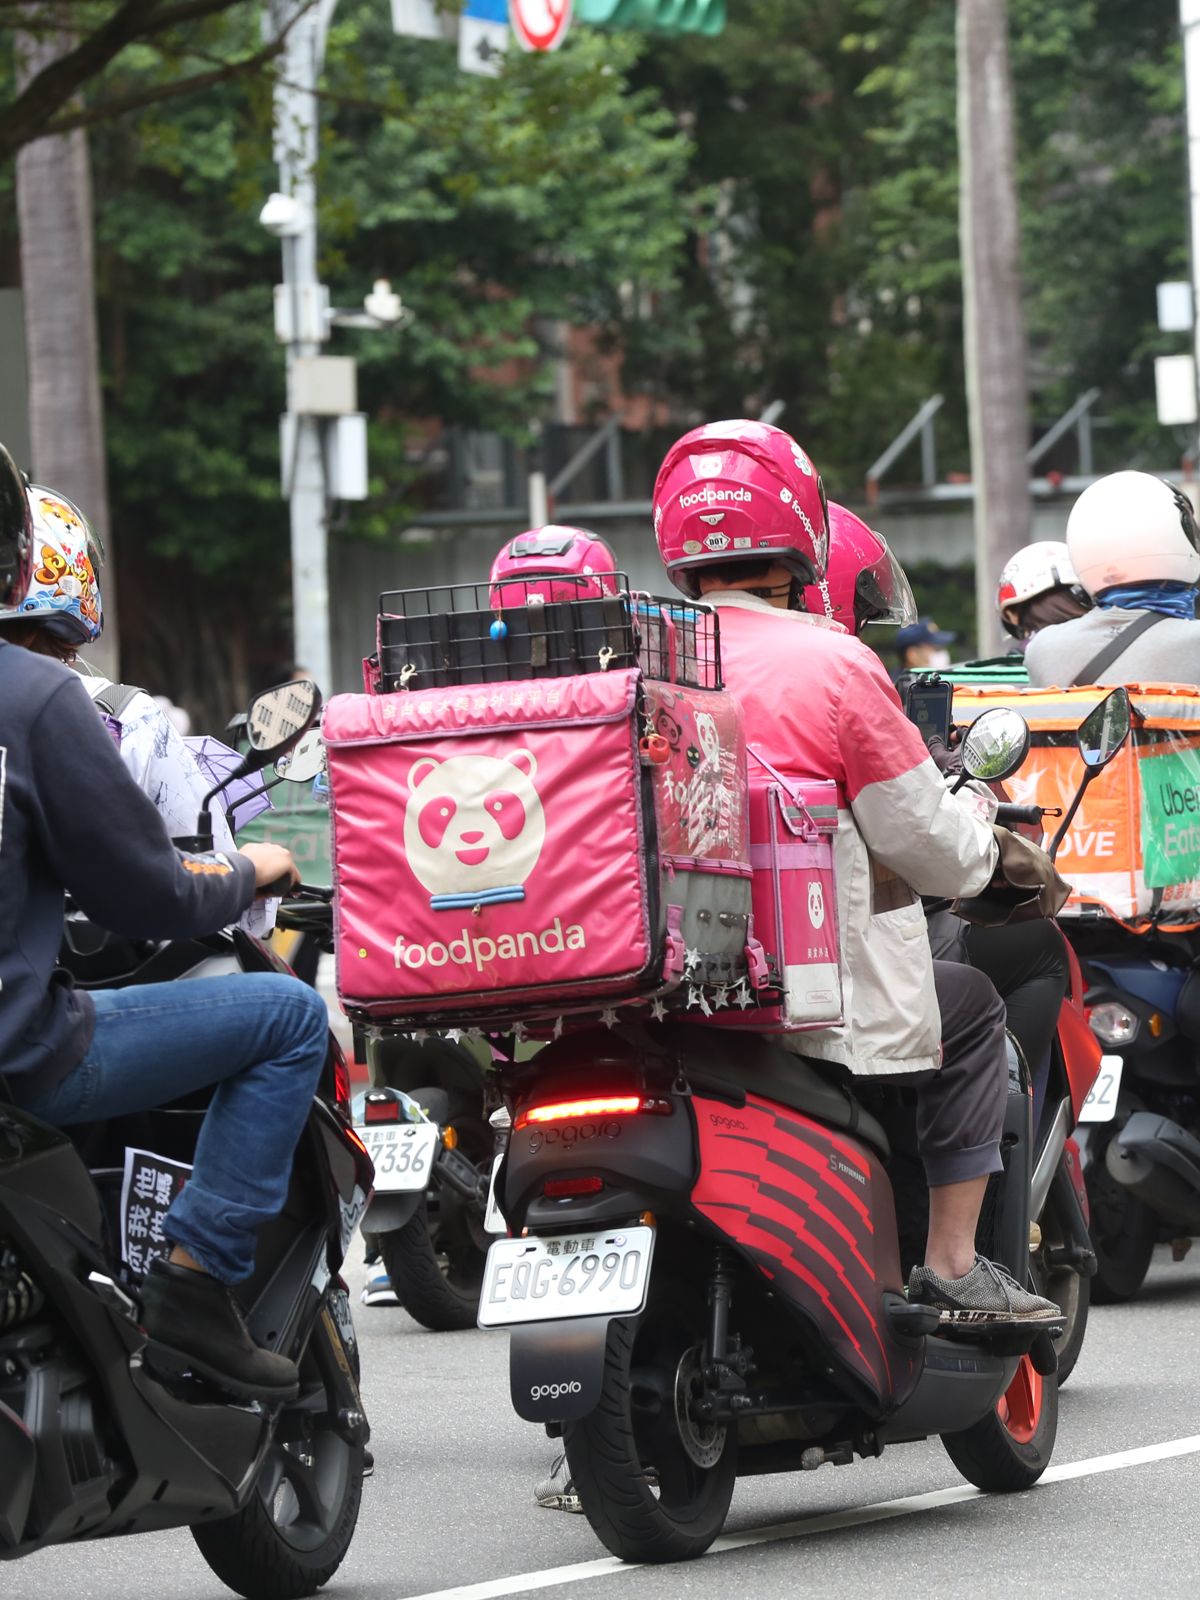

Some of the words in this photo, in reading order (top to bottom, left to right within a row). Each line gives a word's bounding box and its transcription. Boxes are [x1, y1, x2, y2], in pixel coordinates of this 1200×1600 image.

[680, 488, 752, 508] foodpanda
[1159, 784, 1200, 817] Uber
[393, 917, 586, 972] foodpanda
[709, 1113, 746, 1131] gogoro
[529, 1121, 622, 1154] gogoro
[546, 1237, 596, 1256] 電動車
[530, 1380, 582, 1401] gogoro
